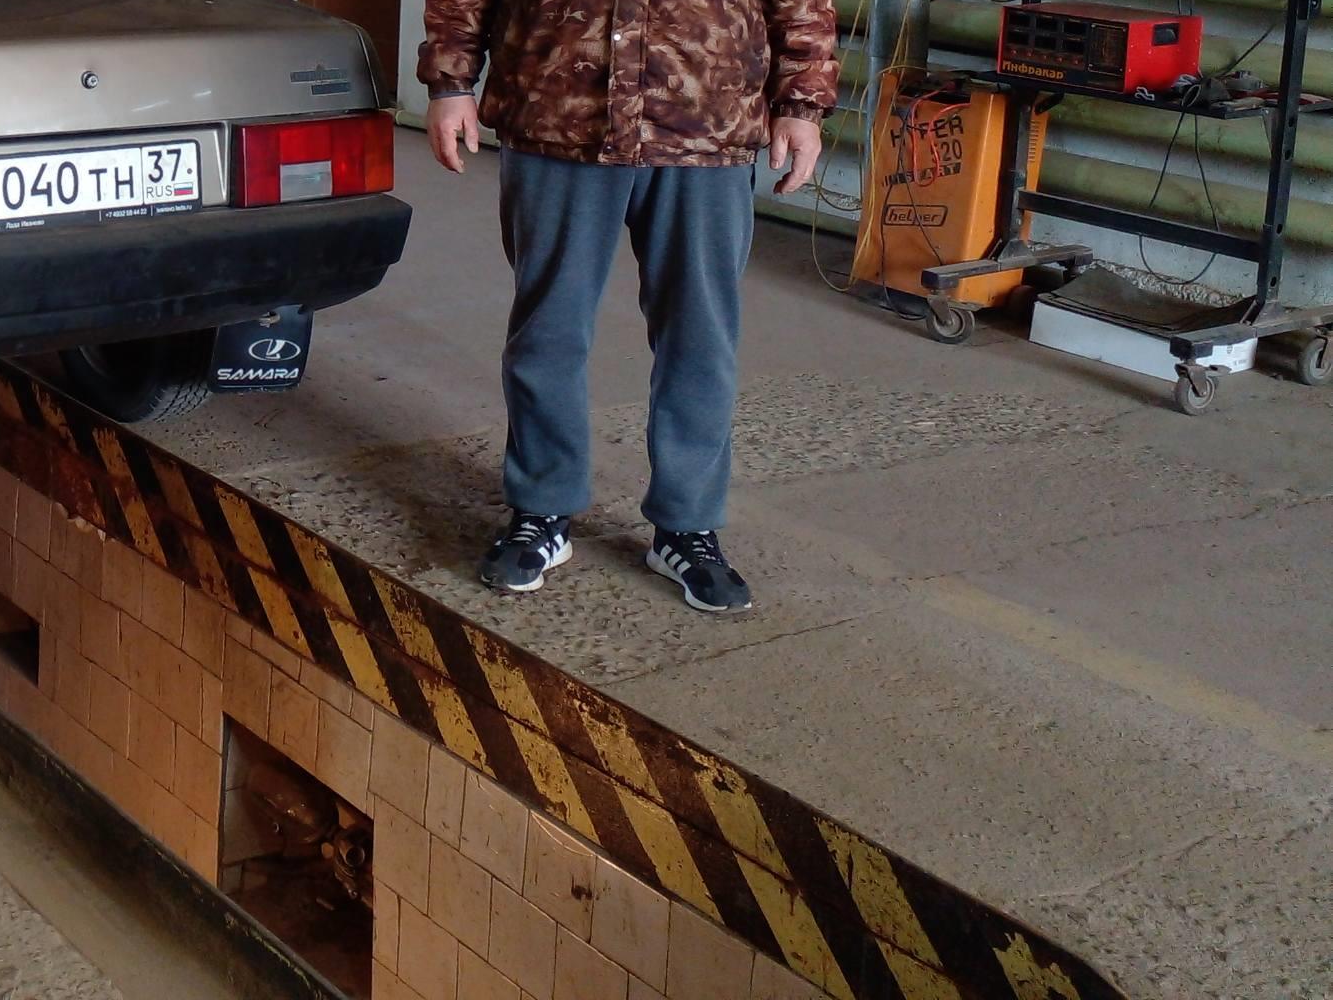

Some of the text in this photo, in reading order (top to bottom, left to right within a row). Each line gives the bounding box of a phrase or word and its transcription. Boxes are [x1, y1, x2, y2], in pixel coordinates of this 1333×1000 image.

[1002, 60, 1064, 79] Инфракар
[148, 148, 181, 183] 37
[147, 185, 172, 198] RUS
[217, 367, 299, 381] SAMARA
